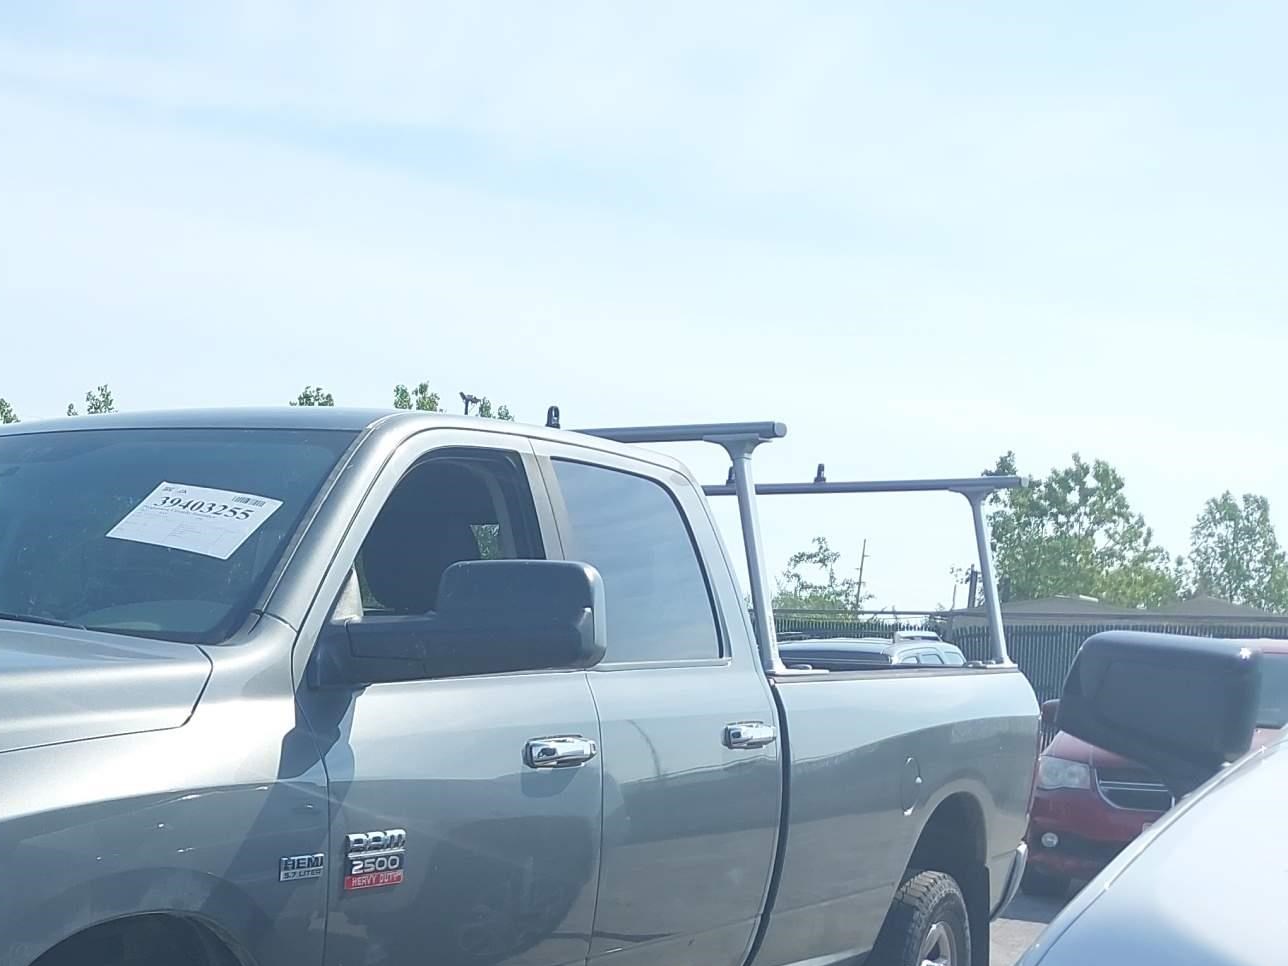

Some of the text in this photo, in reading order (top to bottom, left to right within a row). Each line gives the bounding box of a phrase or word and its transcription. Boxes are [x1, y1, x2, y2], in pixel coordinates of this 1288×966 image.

[153, 496, 255, 521] 39403255
[280, 853, 324, 871] HEMI
[351, 855, 400, 875] 2500
[351, 871, 401, 887] HEAVY DUTY
